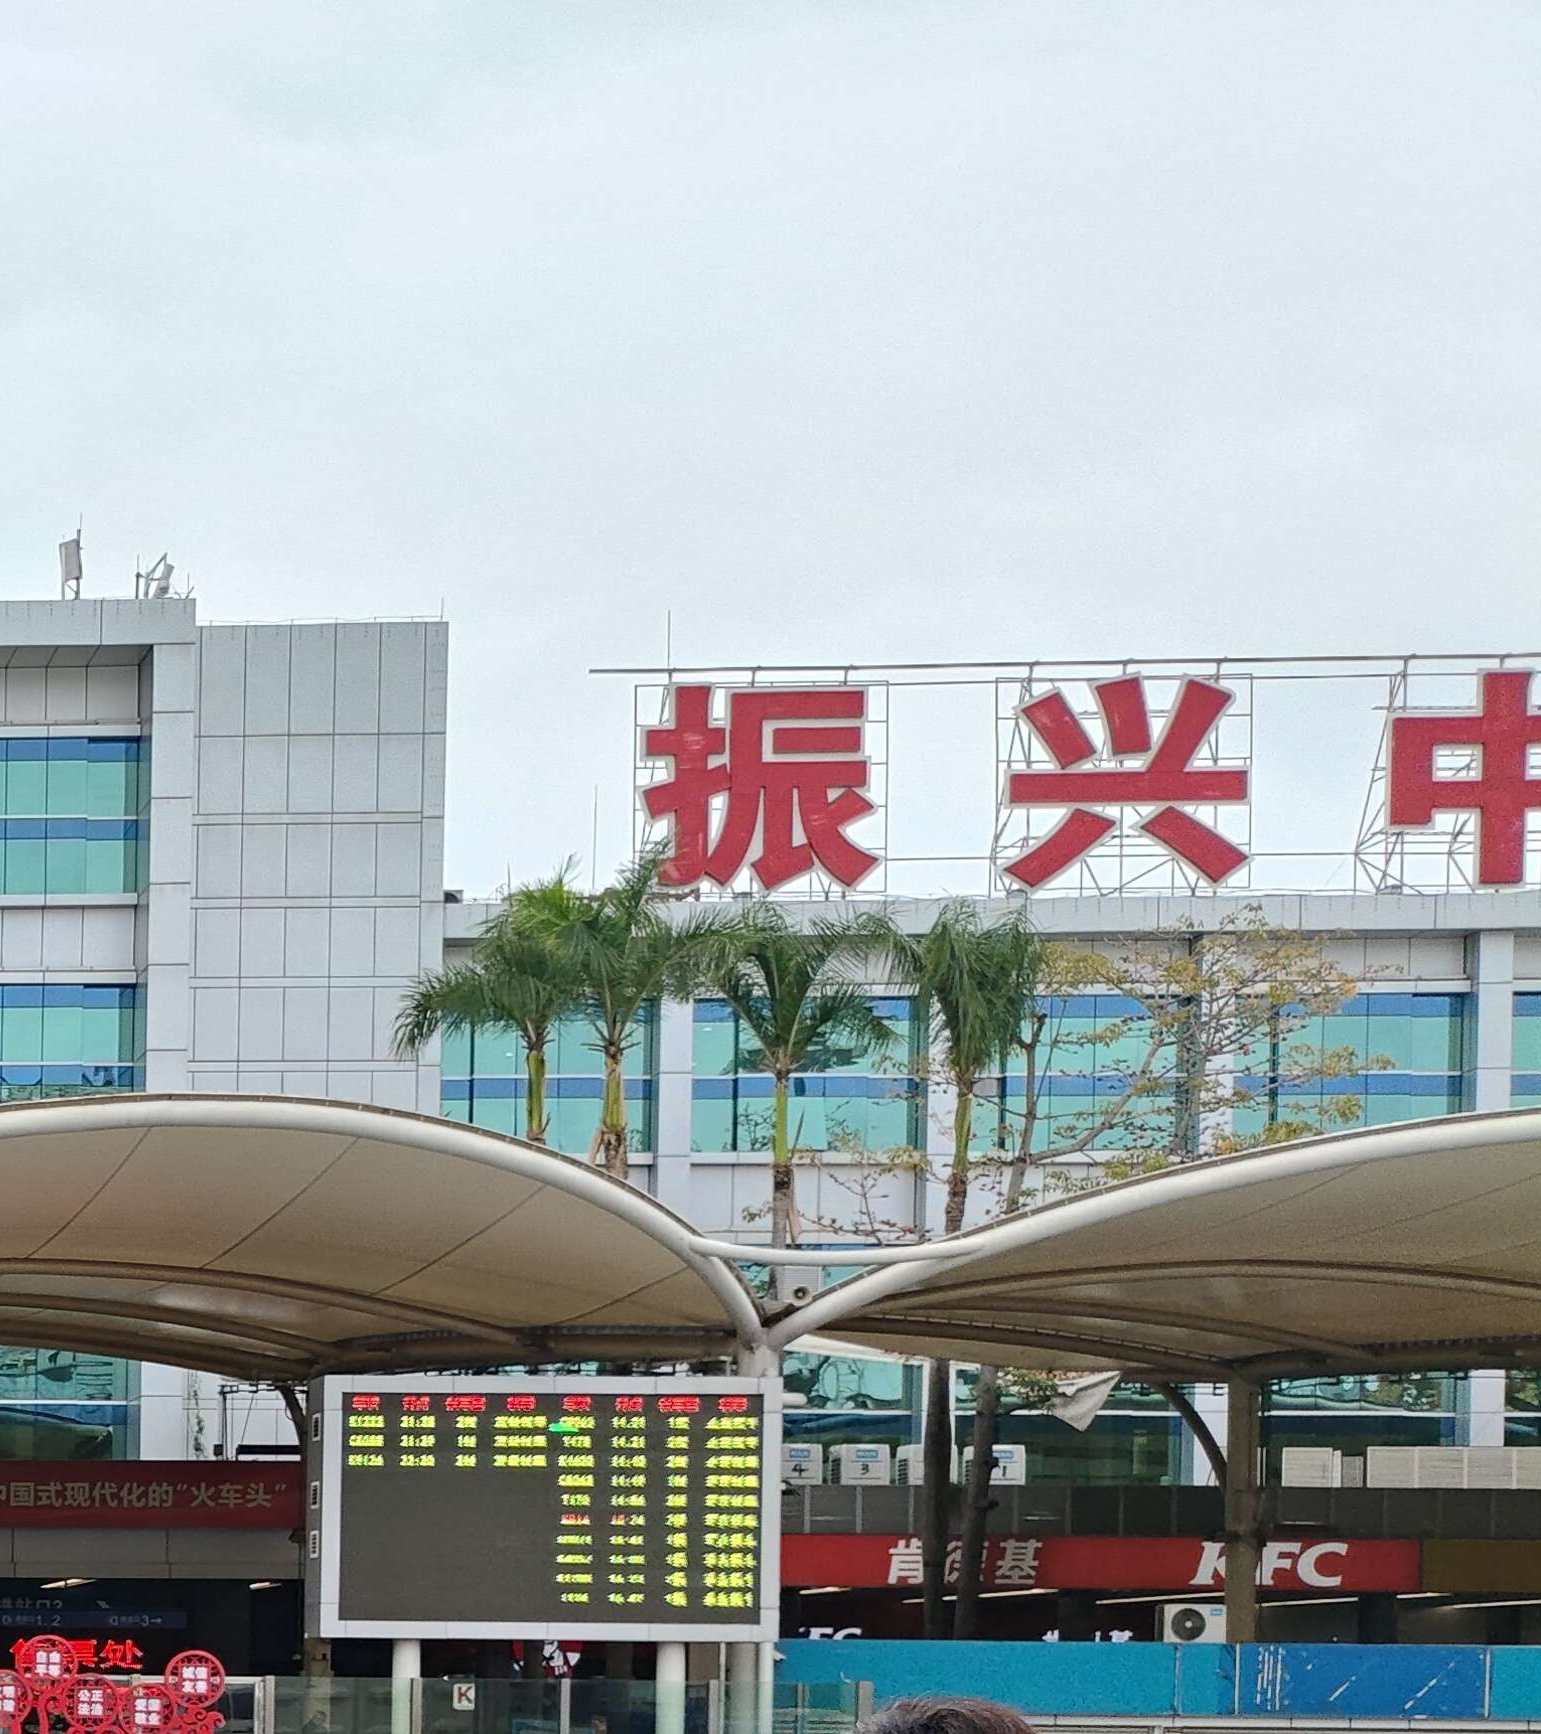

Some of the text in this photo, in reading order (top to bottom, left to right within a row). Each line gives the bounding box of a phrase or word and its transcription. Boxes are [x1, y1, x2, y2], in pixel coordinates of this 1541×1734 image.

[639, 668, 1541, 892] 振兴中
[1188, 1541, 1349, 1588] KFC
[77, 1689, 104, 1702] 公正
[455, 1686, 472, 1706] K
